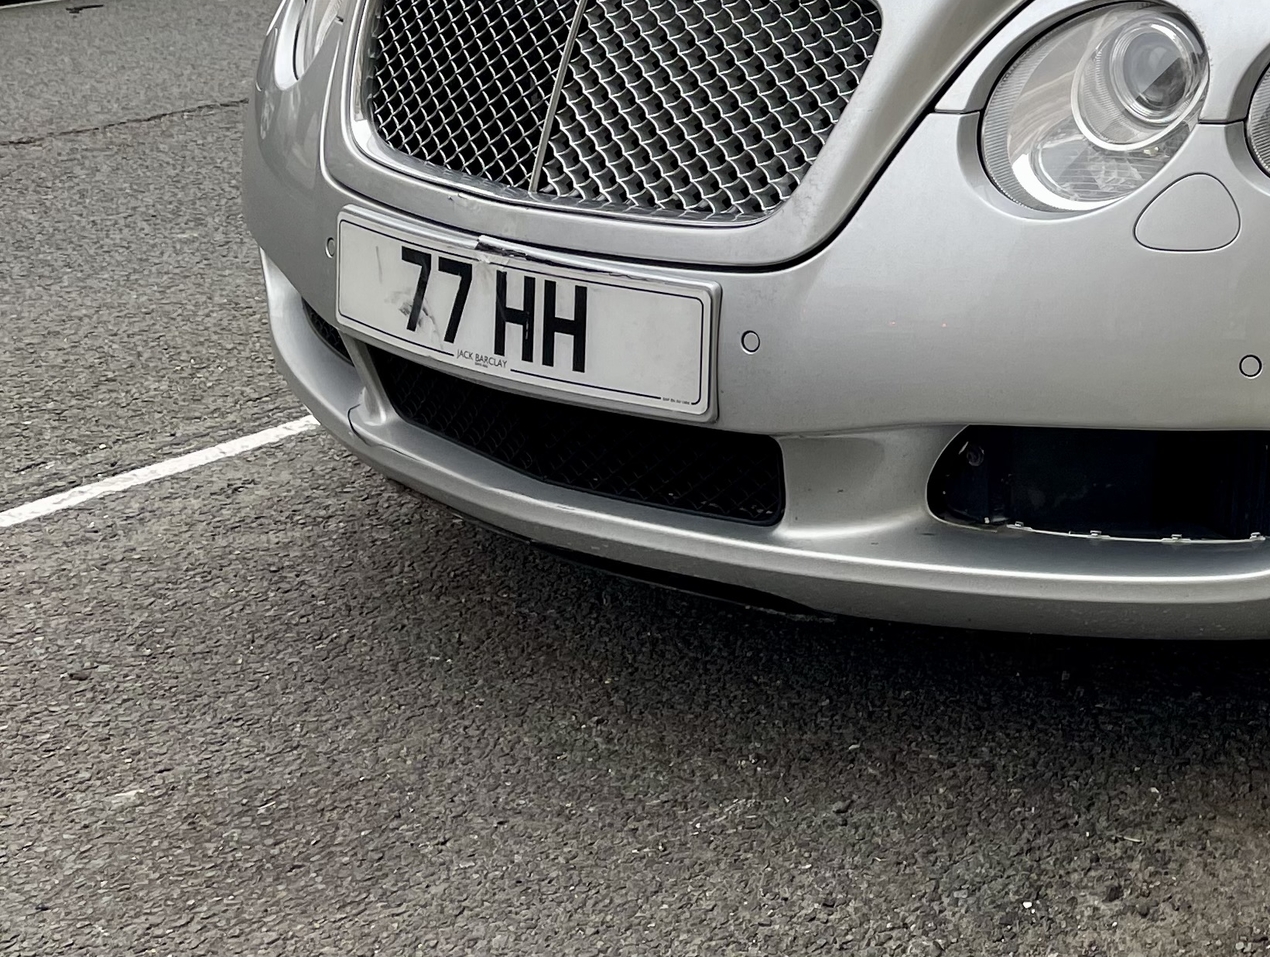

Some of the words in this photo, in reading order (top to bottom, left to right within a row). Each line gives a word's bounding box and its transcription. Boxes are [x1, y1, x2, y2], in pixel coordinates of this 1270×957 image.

[401, 245, 473, 344] 77
[494, 269, 588, 373] HH
[457, 349, 474, 361] JACK
[475, 353, 507, 368] BARCLAY
